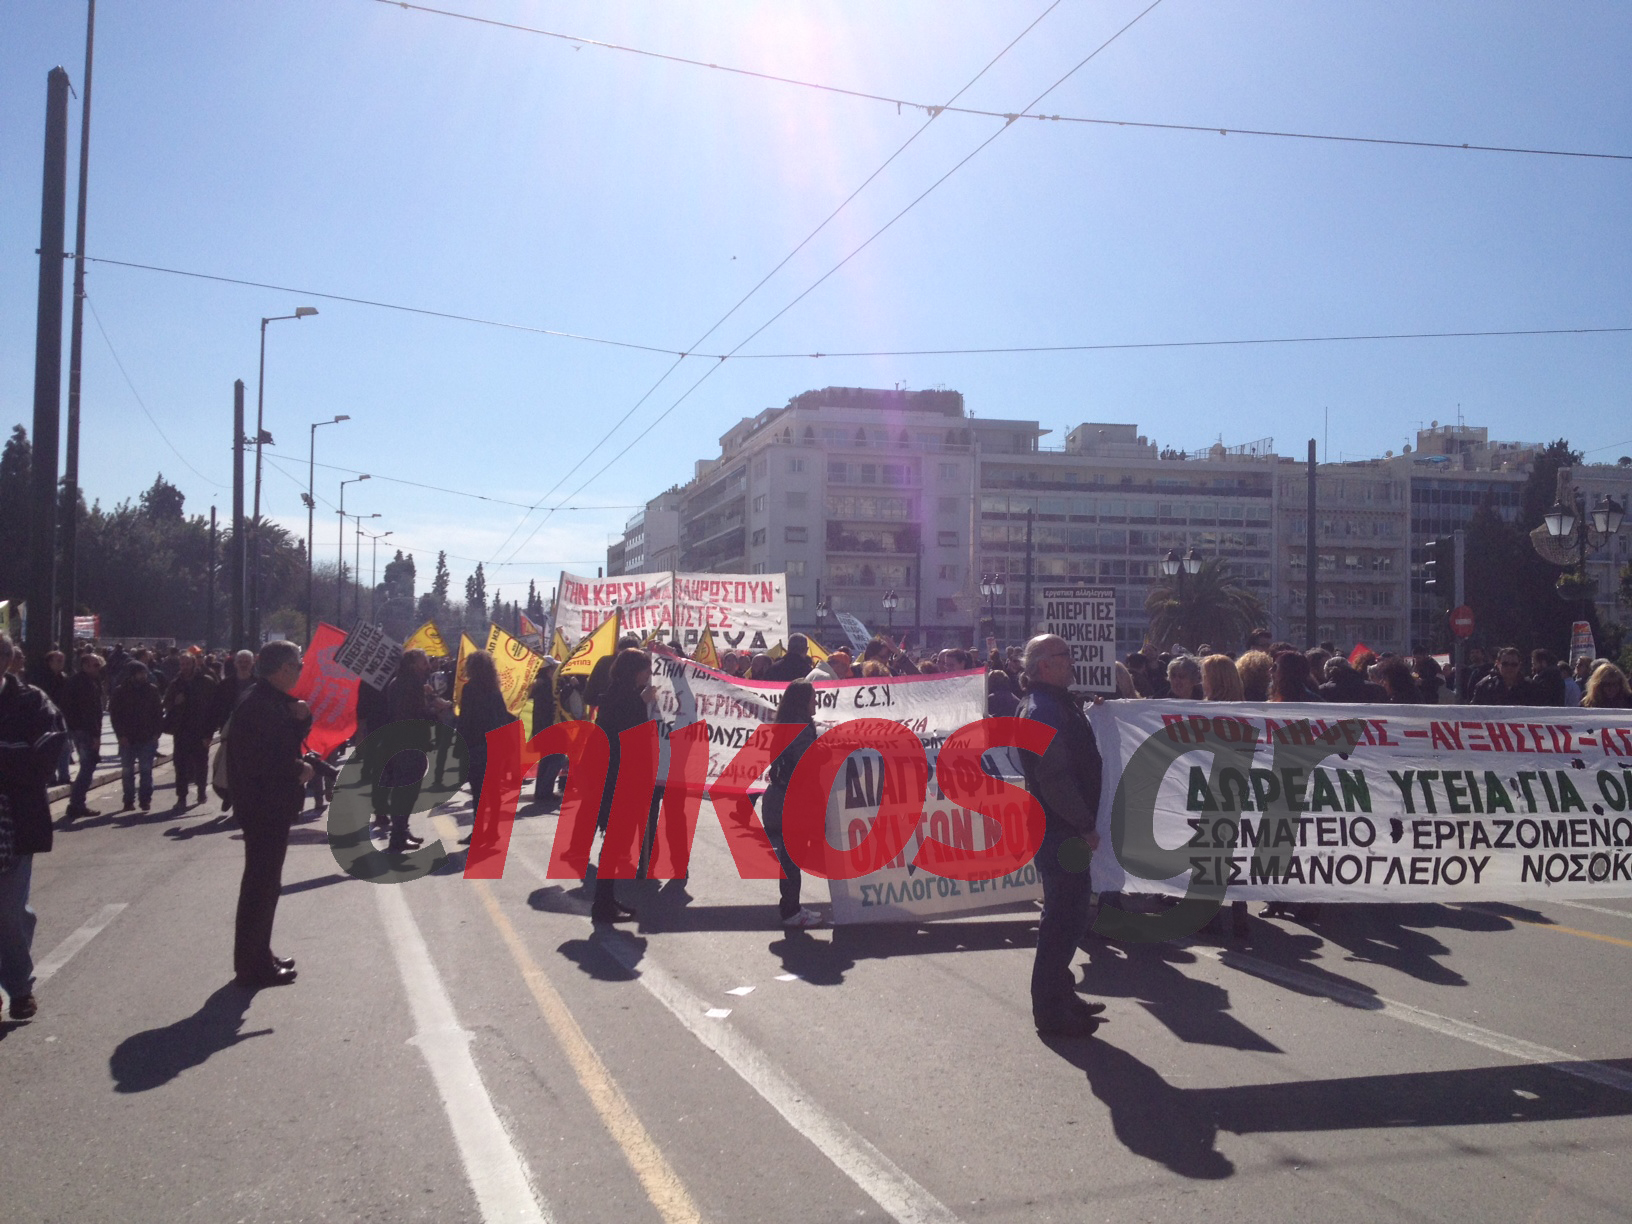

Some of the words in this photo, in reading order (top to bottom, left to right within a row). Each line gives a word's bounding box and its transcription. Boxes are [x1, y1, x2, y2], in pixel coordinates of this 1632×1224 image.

[565, 580, 588, 606] ΤΗΝ
[593, 581, 646, 606] ΚΡΙΣΗ
[1046, 602, 1114, 620] ΑΠΕΡΓΙΕΣ
[1070, 645, 1104, 662] ΕΧΡΙ
[845, 753, 1005, 809] ΔΙΑΓΡΑΦΗ
[1187, 766, 1372, 813] ΔΩΡΕΑΝ
[1387, 769, 1515, 814] ΥΓΕΙΑ
[1516, 770, 1588, 813] ΓΙΑ
[1187, 816, 1377, 849] ΣΩΜΑΤΕΙΟ
[860, 874, 961, 907] ΣΥΛΛΟΓΟΣ
[968, 864, 1042, 894] ΕΡΓΑΖΟ
[1189, 854, 1491, 886] ΣΙΣΜΑΝΟΓΛΕΙΟΥ
[1521, 852, 1632, 883] ΝΟΣΟΚ
